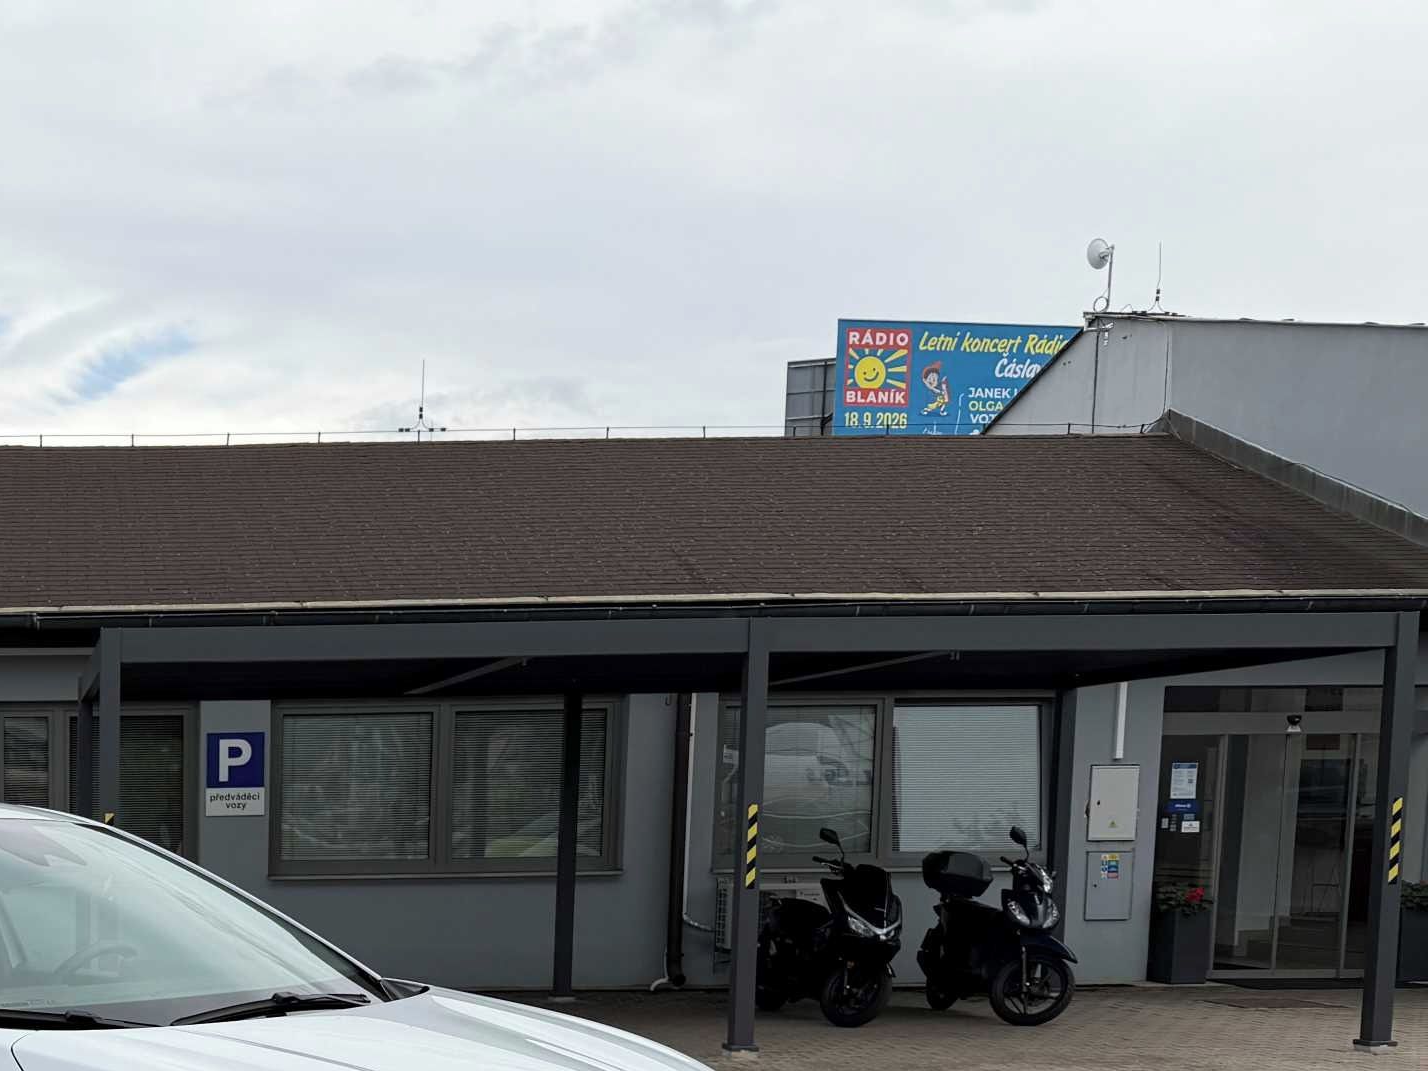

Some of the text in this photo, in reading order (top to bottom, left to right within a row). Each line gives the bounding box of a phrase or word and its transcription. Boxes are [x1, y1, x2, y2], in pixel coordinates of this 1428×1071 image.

[848, 329, 909, 346] RÁDIO
[961, 333, 1022, 354] koncert
[845, 389, 906, 404] BLANÍK
[968, 387, 1011, 399] JANEK
[968, 400, 1004, 412] OLGA
[218, 738, 252, 782] P
[209, 792, 260, 802] předváděcí
[225, 802, 247, 811] vozy
